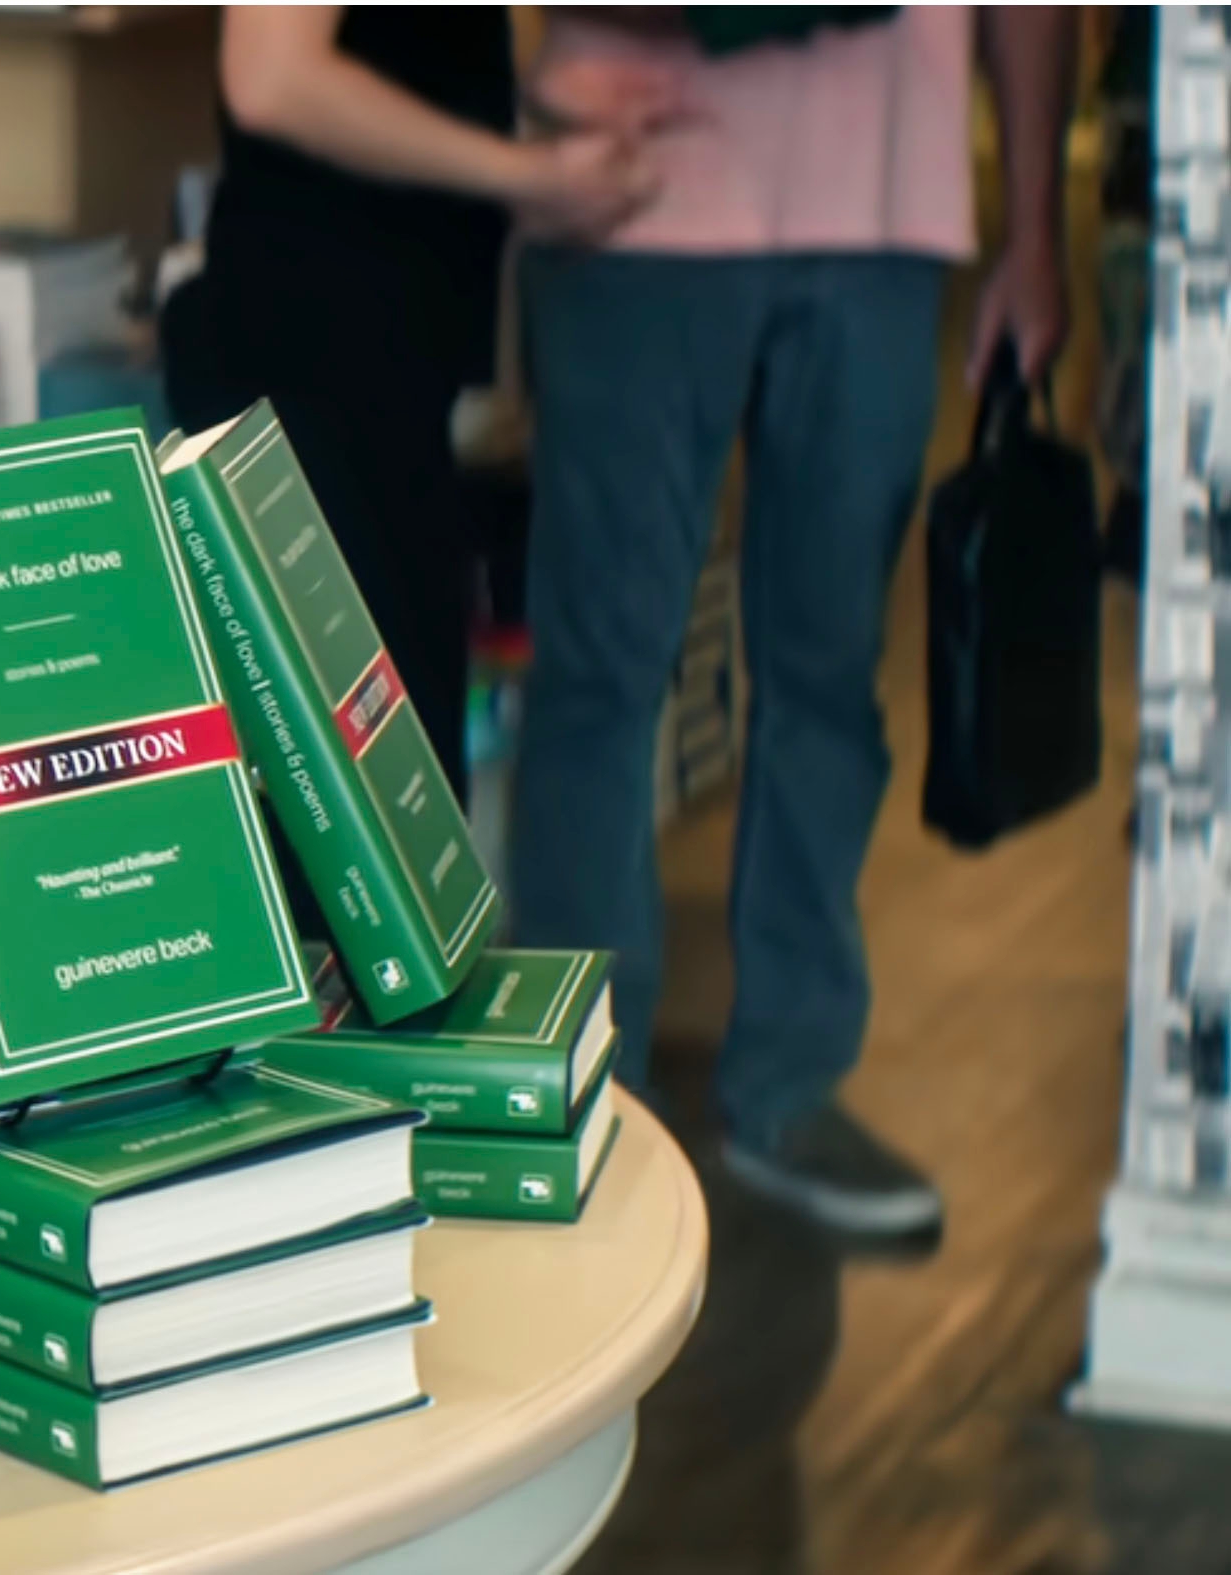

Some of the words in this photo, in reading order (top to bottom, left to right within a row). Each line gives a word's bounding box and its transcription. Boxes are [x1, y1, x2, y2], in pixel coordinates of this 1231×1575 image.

[34, 490, 112, 515] BESTSELLER
[172, 497, 195, 530] the
[11, 562, 56, 585] face
[58, 552, 79, 577] of
[80, 551, 122, 572] love
[185, 531, 216, 575] dark
[205, 574, 234, 618] face
[225, 619, 250, 644] of
[235, 640, 263, 683] love
[257, 691, 296, 755] stories
[49, 728, 187, 782] EDITION
[290, 768, 332, 834] poems
[55, 944, 157, 990] guinevere
[158, 929, 213, 961] beck
